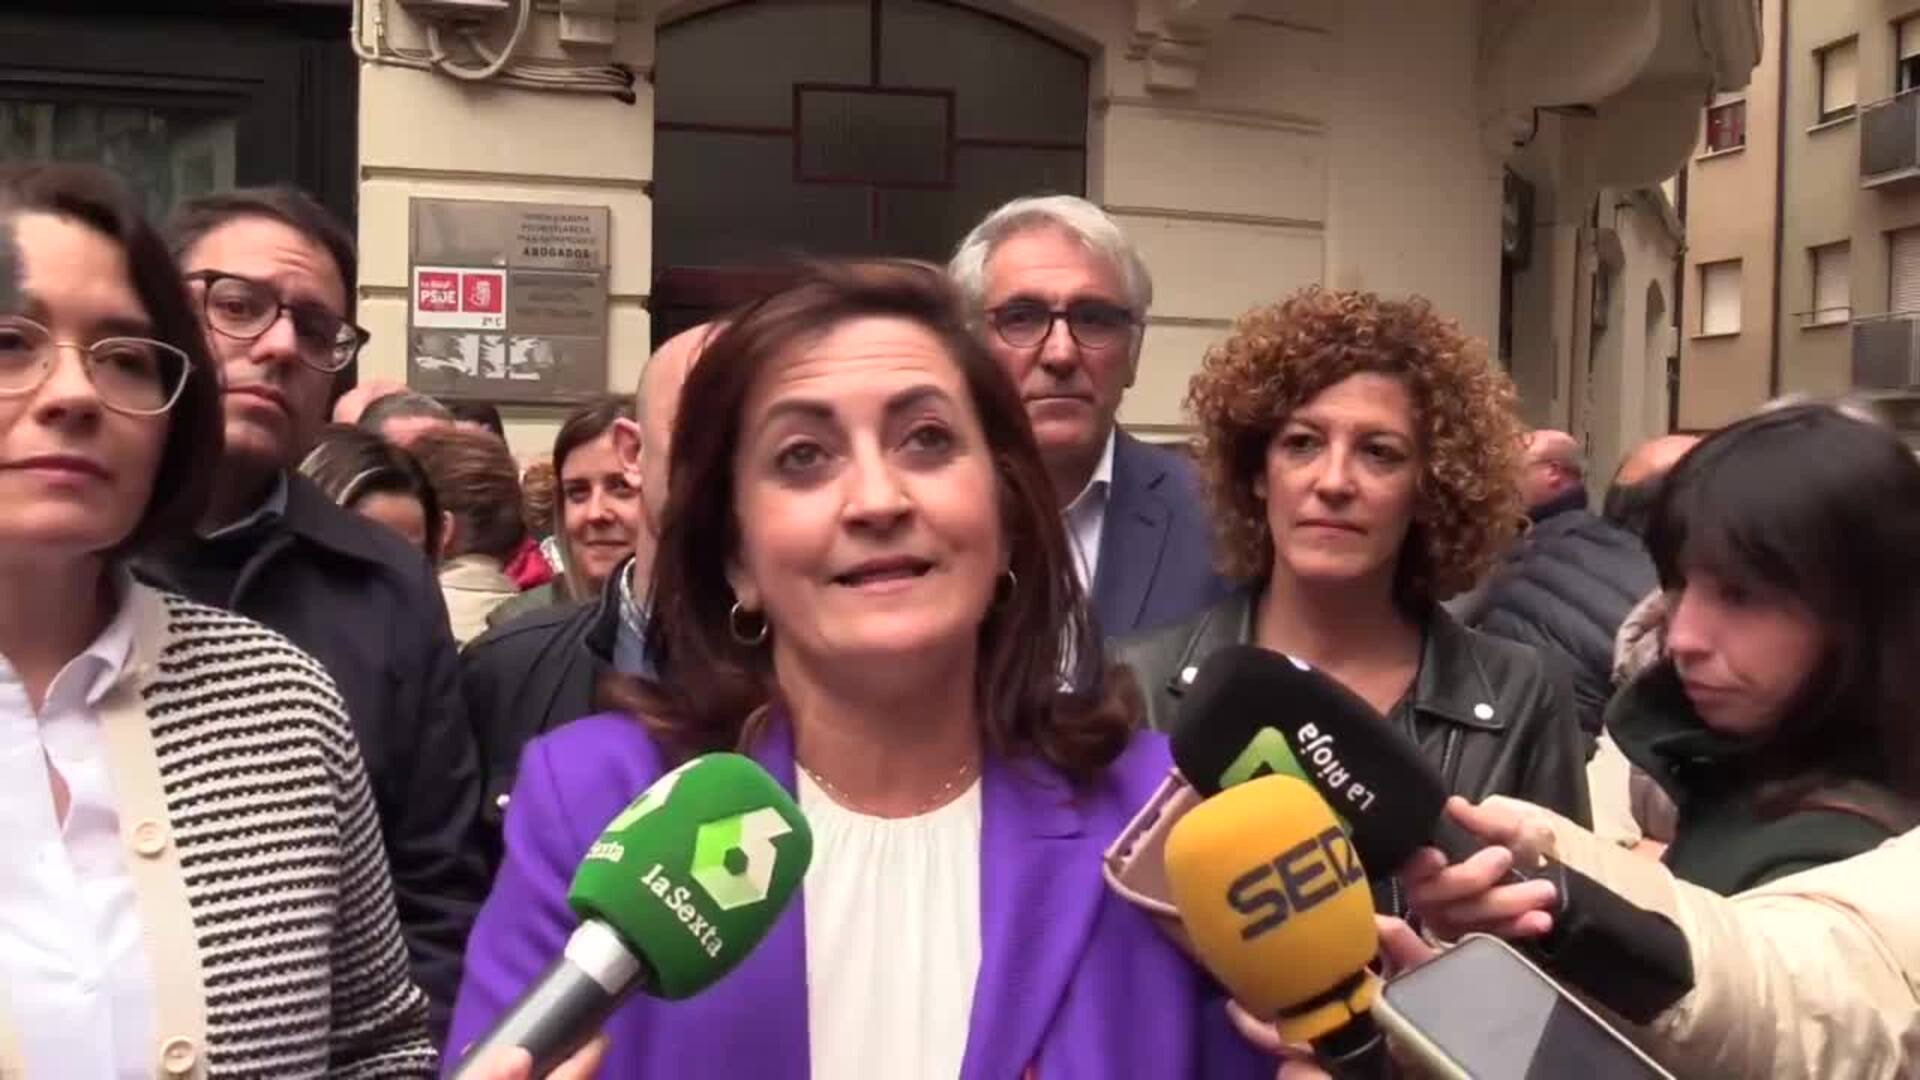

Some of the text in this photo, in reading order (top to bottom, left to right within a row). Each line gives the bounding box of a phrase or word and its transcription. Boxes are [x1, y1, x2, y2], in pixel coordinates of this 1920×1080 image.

[523, 247, 589, 258] ABOGADOS
[420, 288, 457, 305] PSOE
[1297, 722, 1375, 810] La Rioja
[640, 863, 724, 957] laSexta
